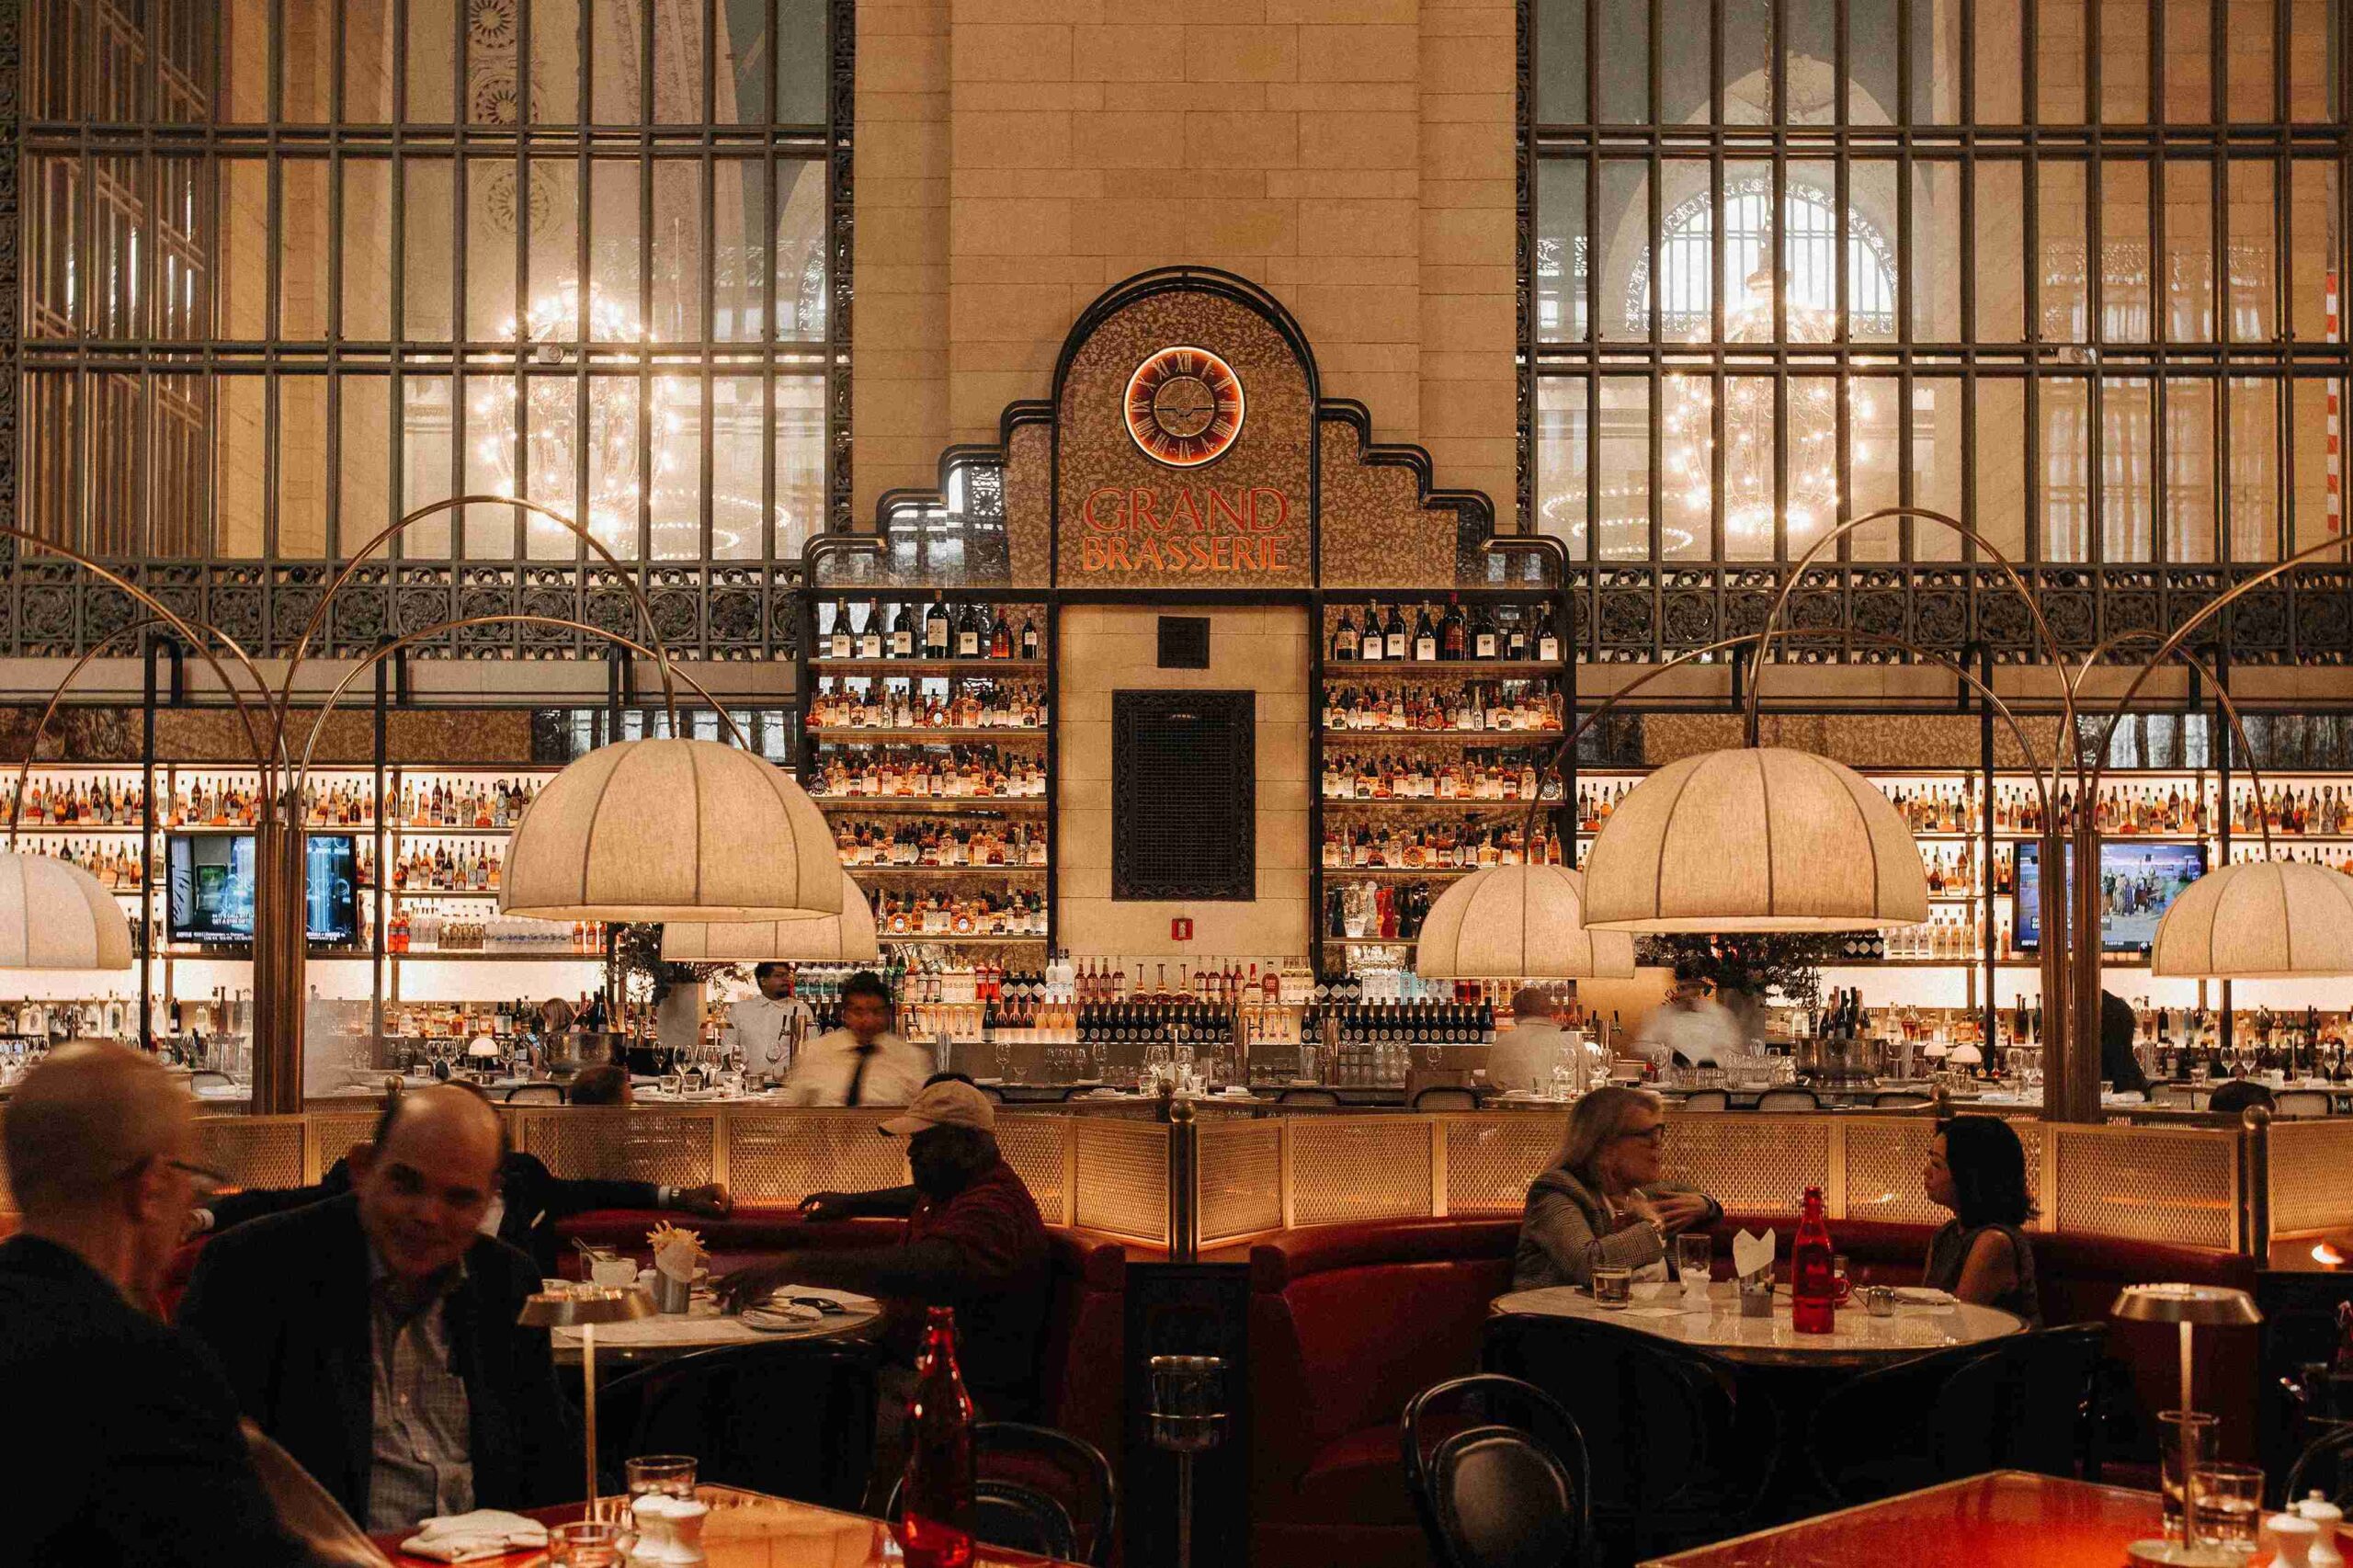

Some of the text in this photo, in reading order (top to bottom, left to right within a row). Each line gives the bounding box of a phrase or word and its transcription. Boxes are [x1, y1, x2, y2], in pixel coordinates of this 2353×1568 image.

[1153, 358, 1170, 381] XI
[1176, 353, 1192, 372] XII
[1138, 376, 1157, 392] X
[1213, 376, 1233, 392] II
[1131, 400, 1150, 413] IX
[1218, 399, 1236, 413] III
[1178, 440, 1191, 460] VI
[1084, 487, 1290, 532] GRAND
[1083, 536, 1290, 571] BRASSERIE
